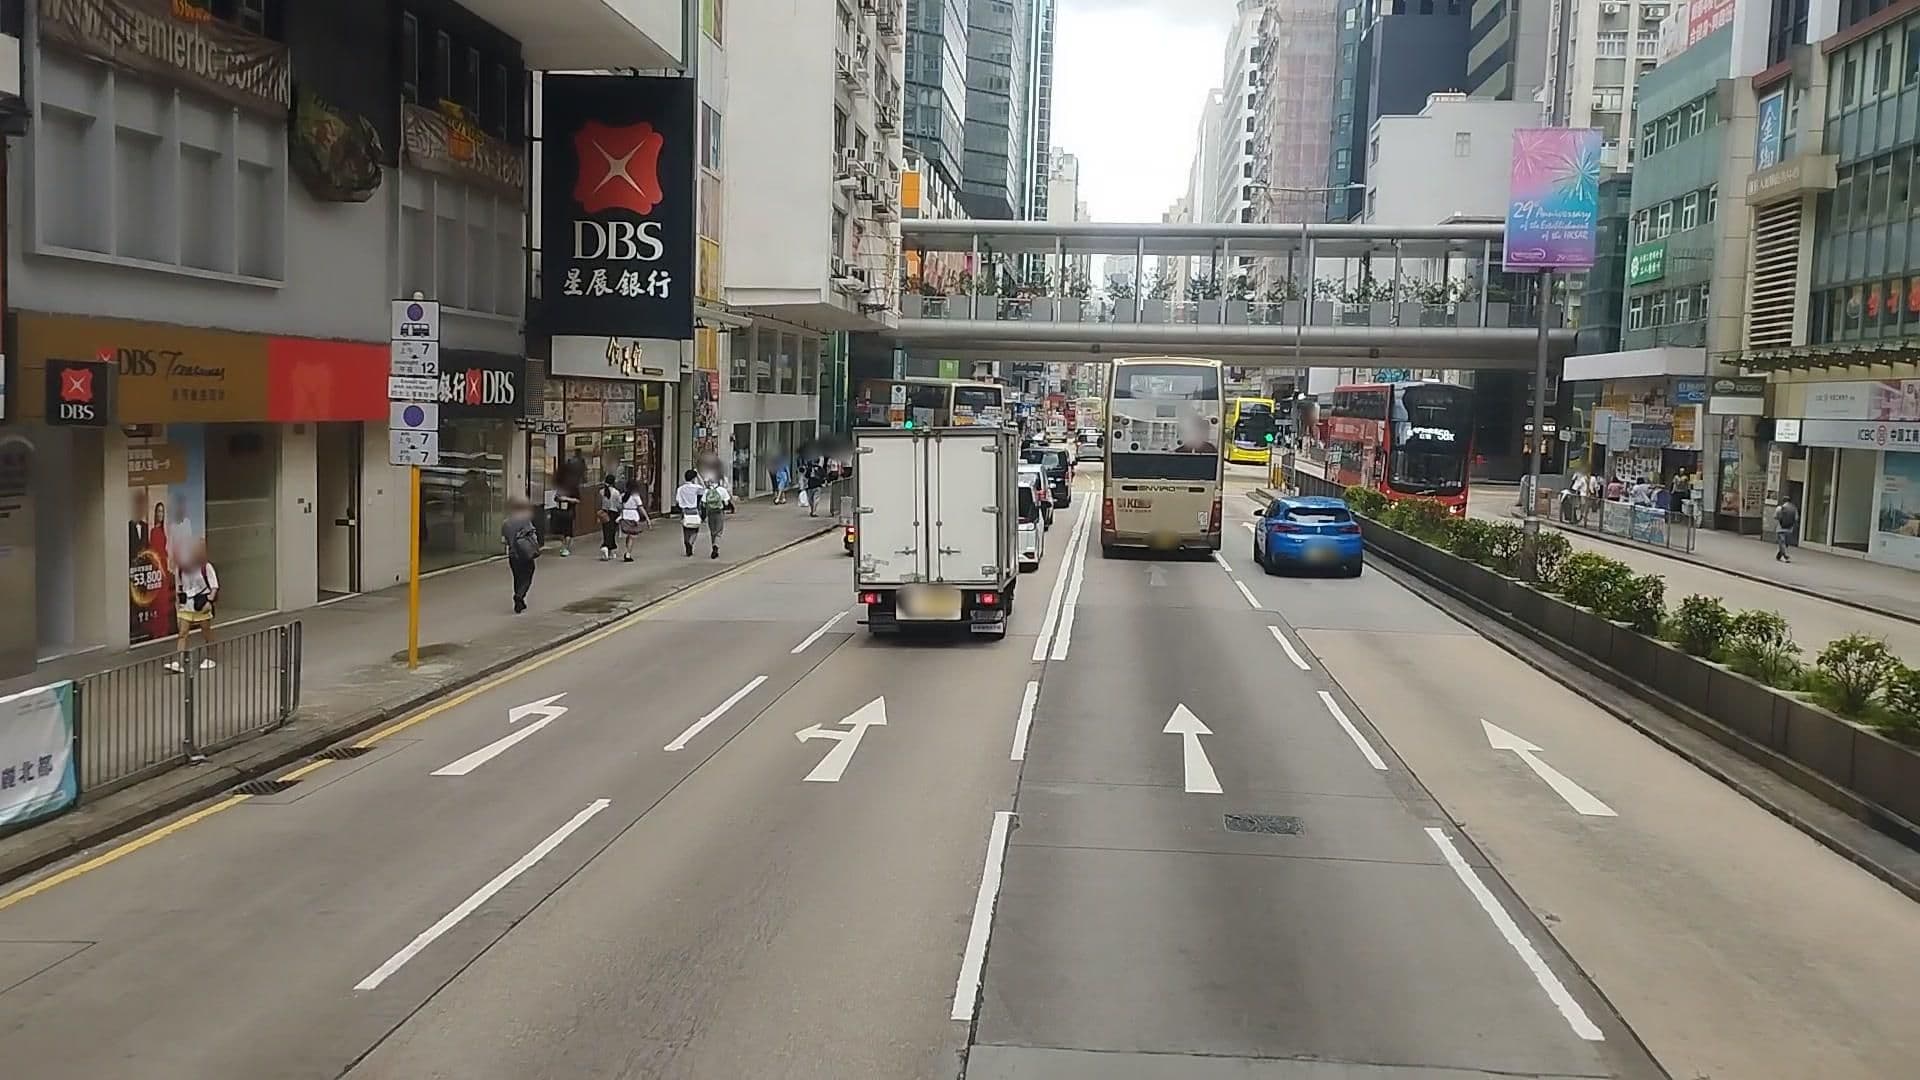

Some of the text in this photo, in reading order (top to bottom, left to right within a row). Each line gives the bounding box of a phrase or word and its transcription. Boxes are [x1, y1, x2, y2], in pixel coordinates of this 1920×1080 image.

[1536, 206, 1592, 222] Anniversary
[573, 220, 664, 261] DBS
[563, 268, 672, 299] 星展銀行
[421, 343, 430, 355] 7
[117, 348, 156, 376] DBS
[421, 362, 436, 374] 12
[482, 370, 515, 404] DBS
[60, 403, 95, 420] DBS
[420, 433, 429, 445] 7
[1858, 428, 1875, 441] ICBC
[420, 452, 429, 463] 7
